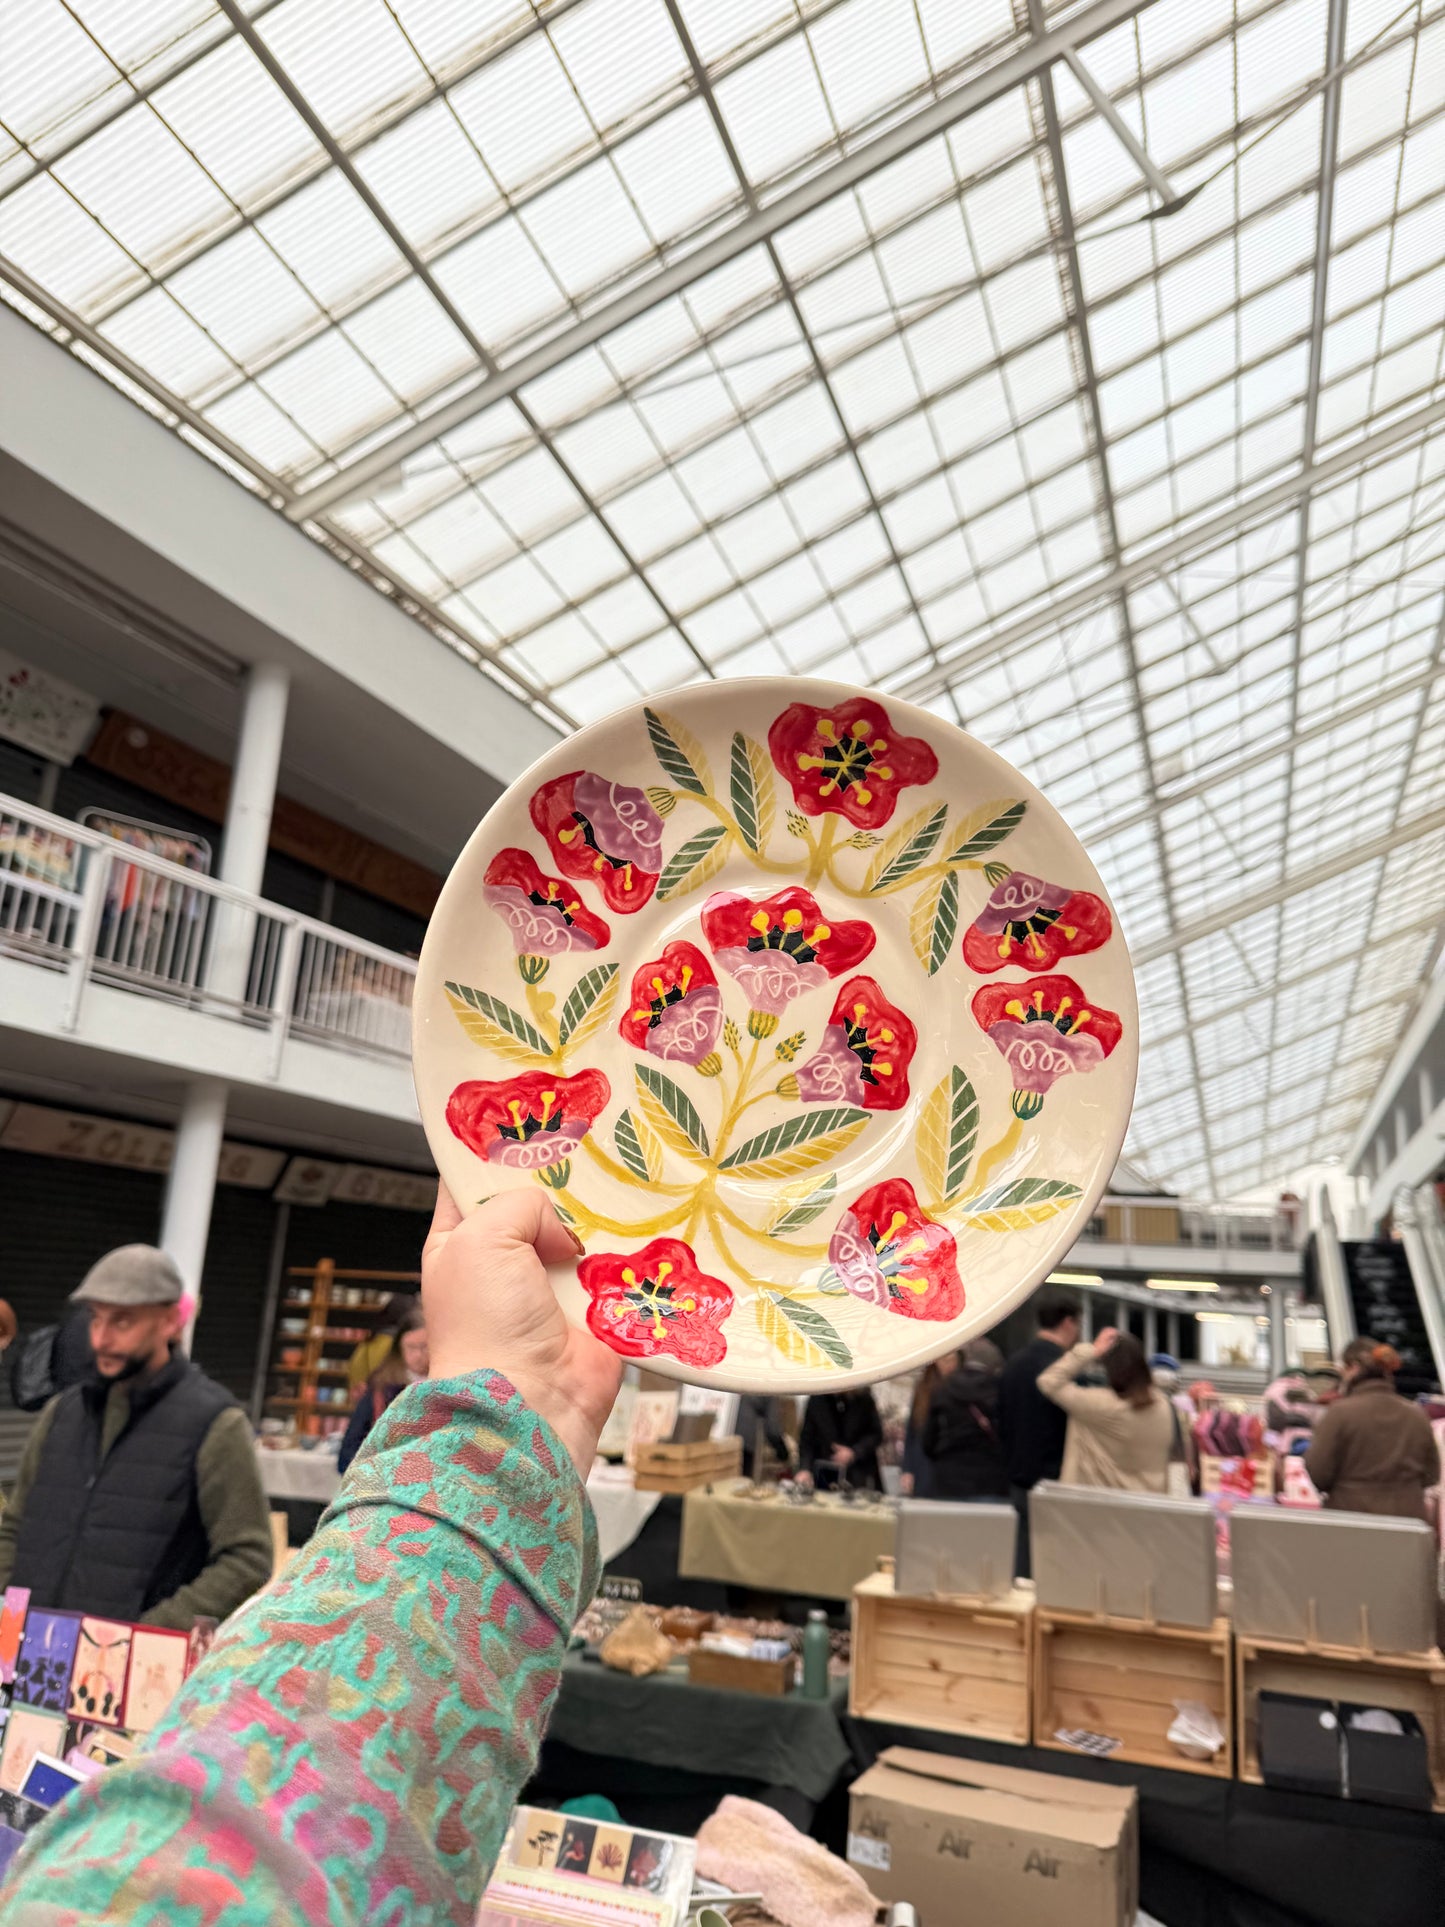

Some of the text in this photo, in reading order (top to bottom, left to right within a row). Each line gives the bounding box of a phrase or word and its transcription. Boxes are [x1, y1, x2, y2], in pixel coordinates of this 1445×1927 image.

[858, 1809, 891, 1838] Air
[937, 1829, 974, 1860] Air
[1023, 1848, 1061, 1880] Air
